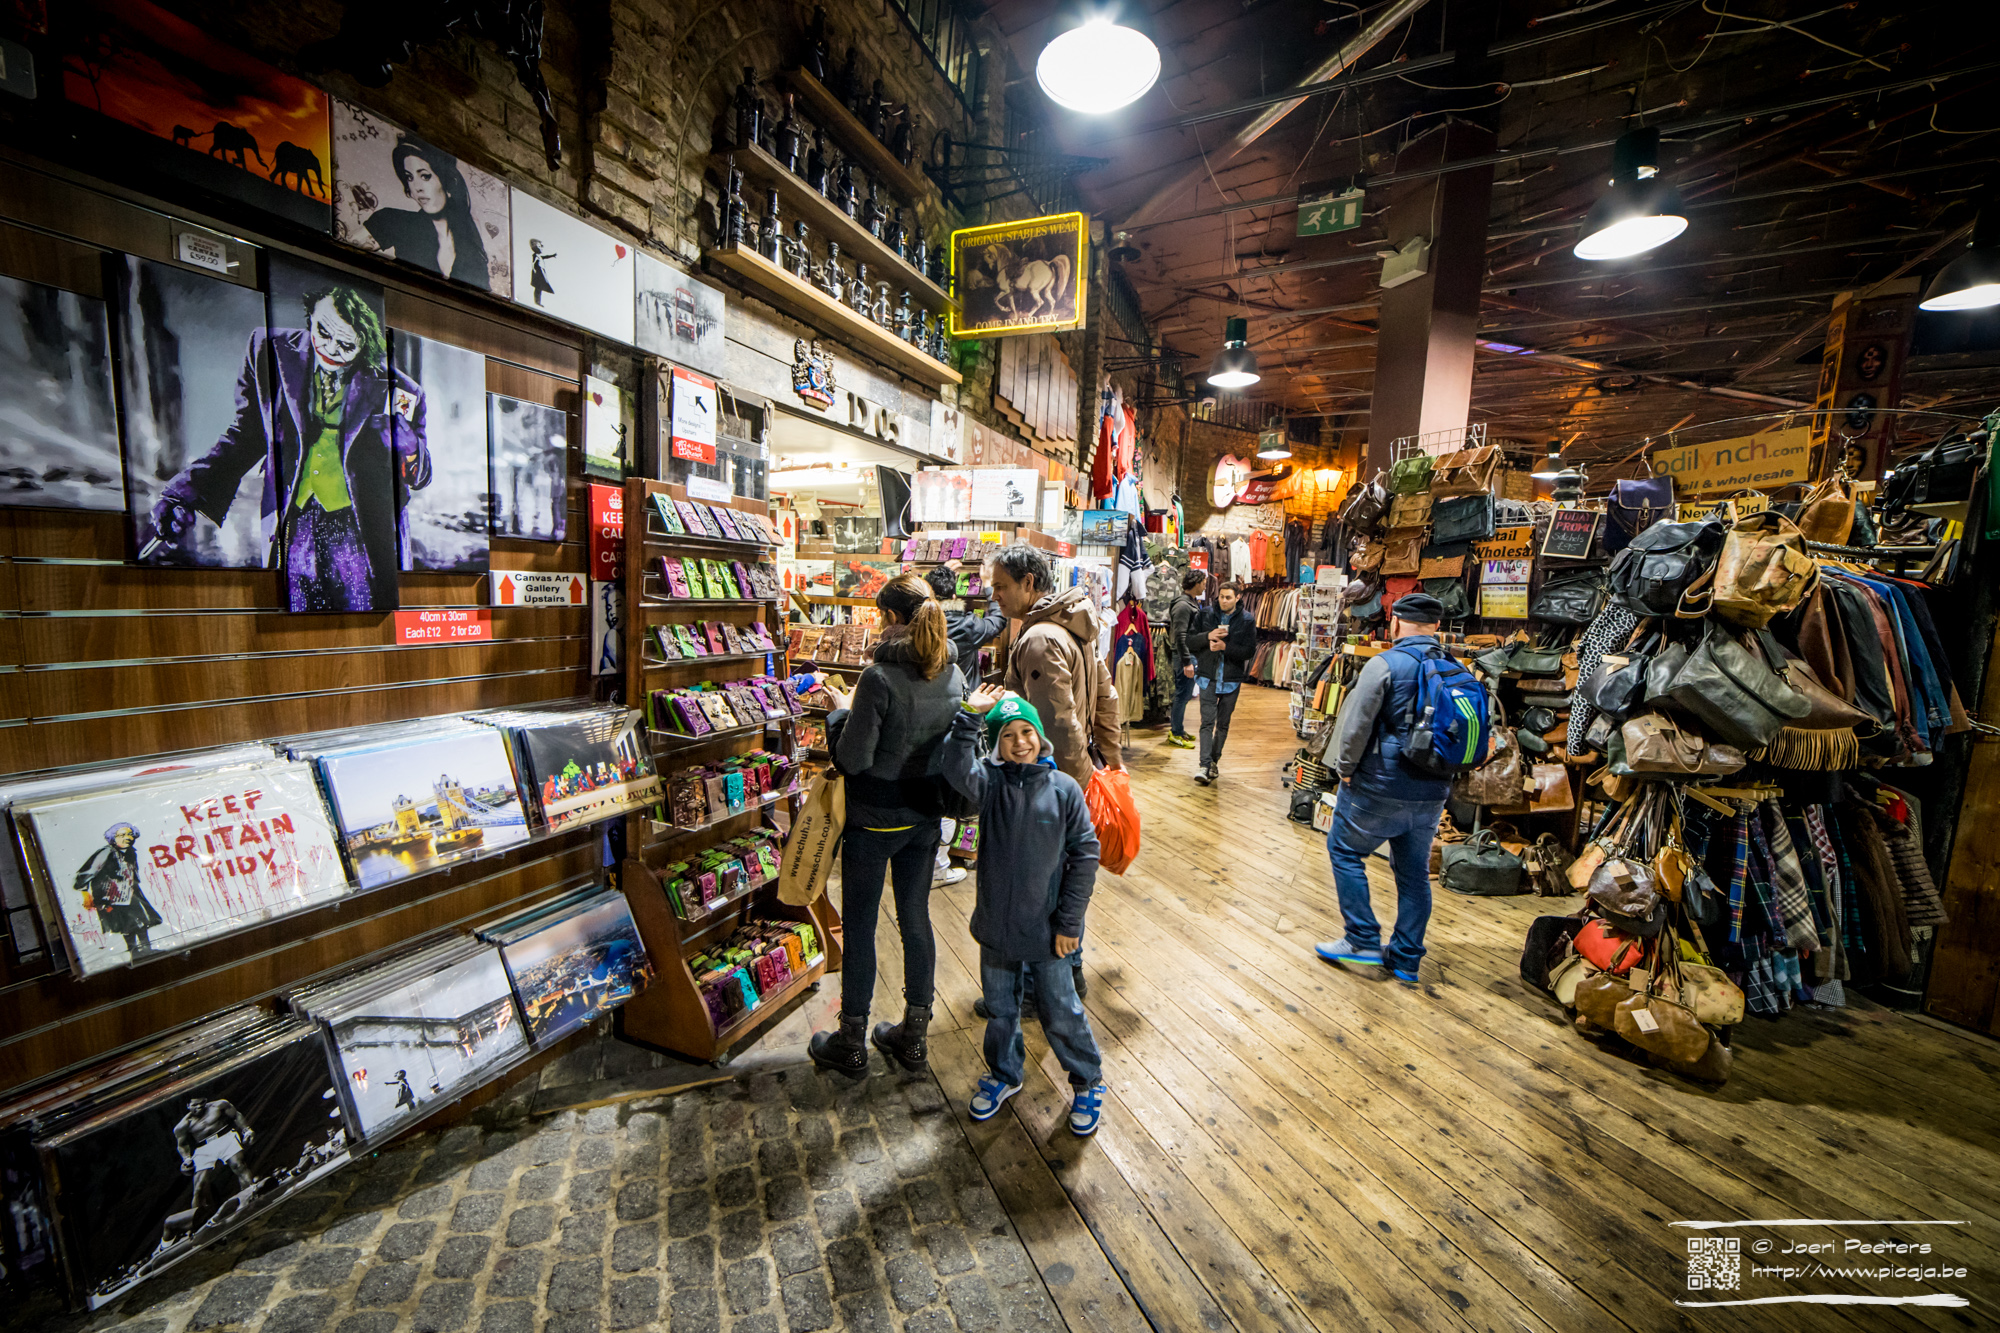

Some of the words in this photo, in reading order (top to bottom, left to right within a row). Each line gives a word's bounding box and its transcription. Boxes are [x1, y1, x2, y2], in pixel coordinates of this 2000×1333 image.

[960, 233, 1006, 249] ORIGINAL
[1006, 225, 1048, 241] STABLES
[1049, 221, 1079, 235] WEAR
[187, 244, 219, 258] CANVAS
[975, 320, 1001, 330] COME
[1004, 318, 1017, 327] IN
[1018, 316, 1038, 326] AND
[1040, 314, 1059, 324] TRY
[1654, 438, 1804, 476] odilynch.com
[1703, 479, 1713, 489] &
[1717, 468, 1794, 487] wholesale
[602, 511, 624, 524] KEE
[1682, 509, 1715, 519] New
[1735, 503, 1760, 516] Old
[602, 527, 624, 539] CAL
[1555, 522, 1593, 533] PROMO
[1479, 529, 1518, 542] etail
[601, 551, 626, 563] CARR
[1475, 545, 1535, 558] Wholesa
[1191, 555, 1202, 567] £5
[515, 573, 552, 582] Canvas
[554, 574, 570, 583] Art
[525, 584, 560, 594] Gallery
[524, 595, 565, 603] Upstairs
[419, 612, 441, 623] 40cm
[441, 614, 447, 622] x
[448, 611, 468, 622] 30cm
[405, 628, 425, 639] Each
[426, 627, 441, 638] £12
[451, 626, 457, 636] 2
[457, 625, 467, 636] for
[468, 625, 482, 636] £20
[180, 790, 263, 824] KEEP
[149, 813, 295, 868] BRITAIN
[790, 815, 812, 878] www.schuh.ie
[202, 848, 276, 880] TIDY
